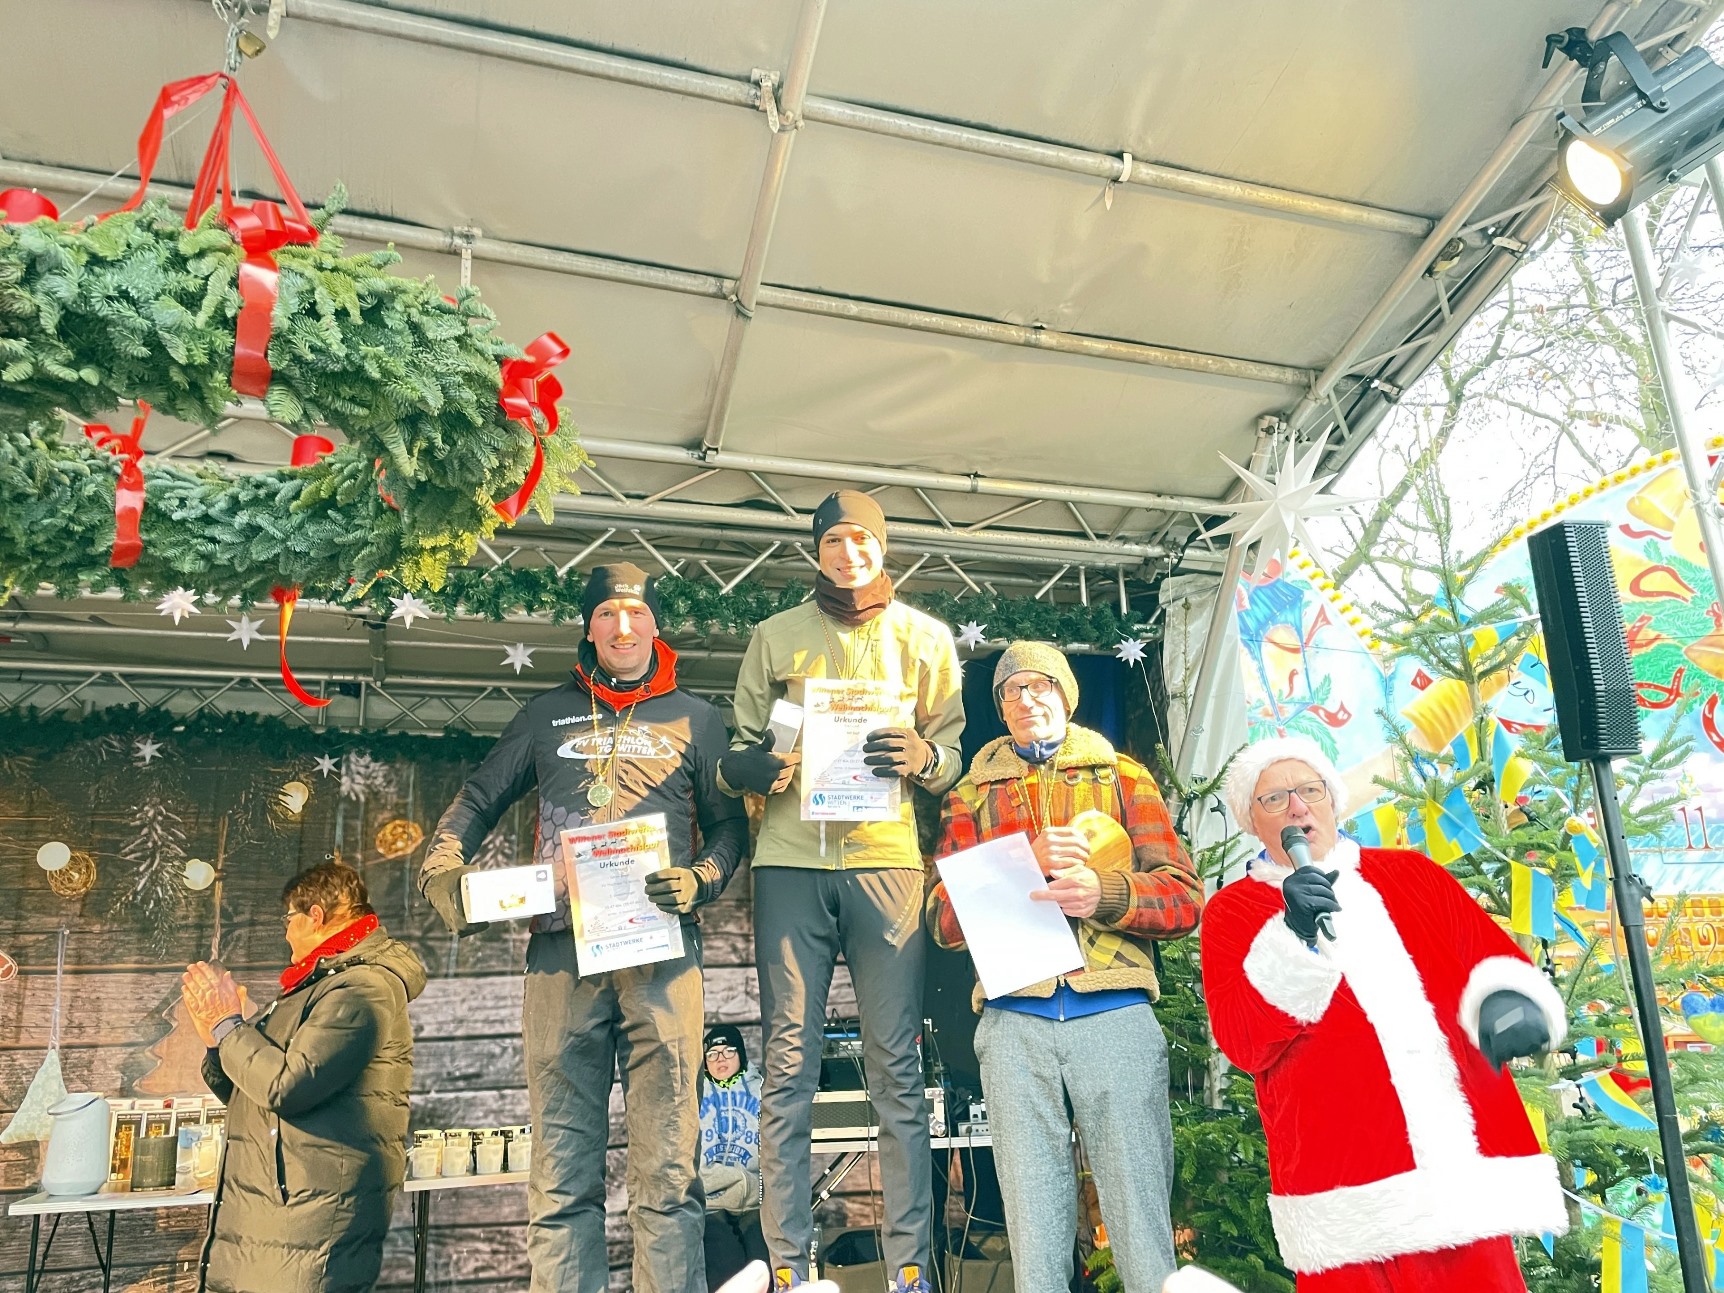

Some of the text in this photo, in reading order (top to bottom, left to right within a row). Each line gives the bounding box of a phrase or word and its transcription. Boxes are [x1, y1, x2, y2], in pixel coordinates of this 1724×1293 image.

[834, 715, 868, 724] Urkunde
[616, 744, 657, 756] WITTEN
[599, 858, 635, 869] Urkunde
[605, 937, 644, 949] STADTWERKE
